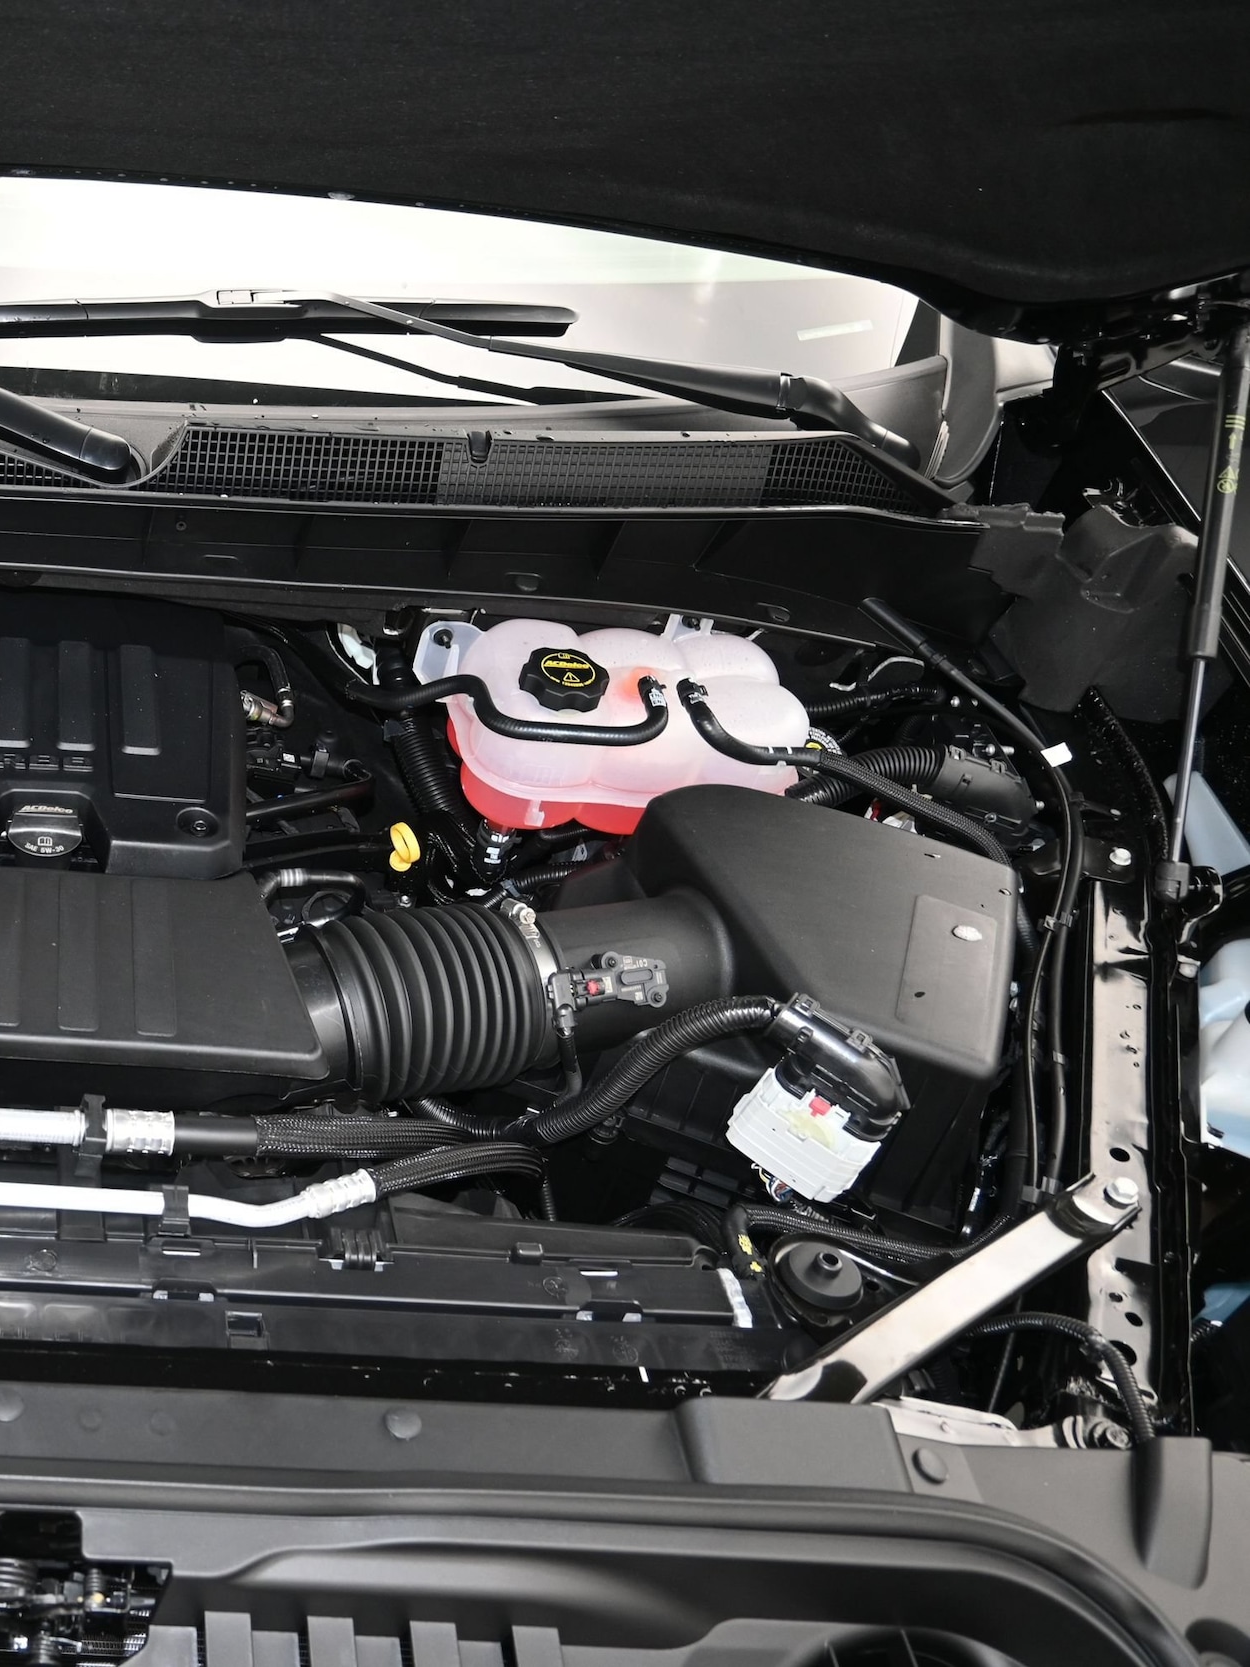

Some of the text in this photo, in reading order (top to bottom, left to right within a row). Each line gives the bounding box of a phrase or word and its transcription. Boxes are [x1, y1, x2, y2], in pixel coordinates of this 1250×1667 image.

[18, 805, 74, 814] ACDelco
[24, 841, 65, 854] SAE 5W-30
